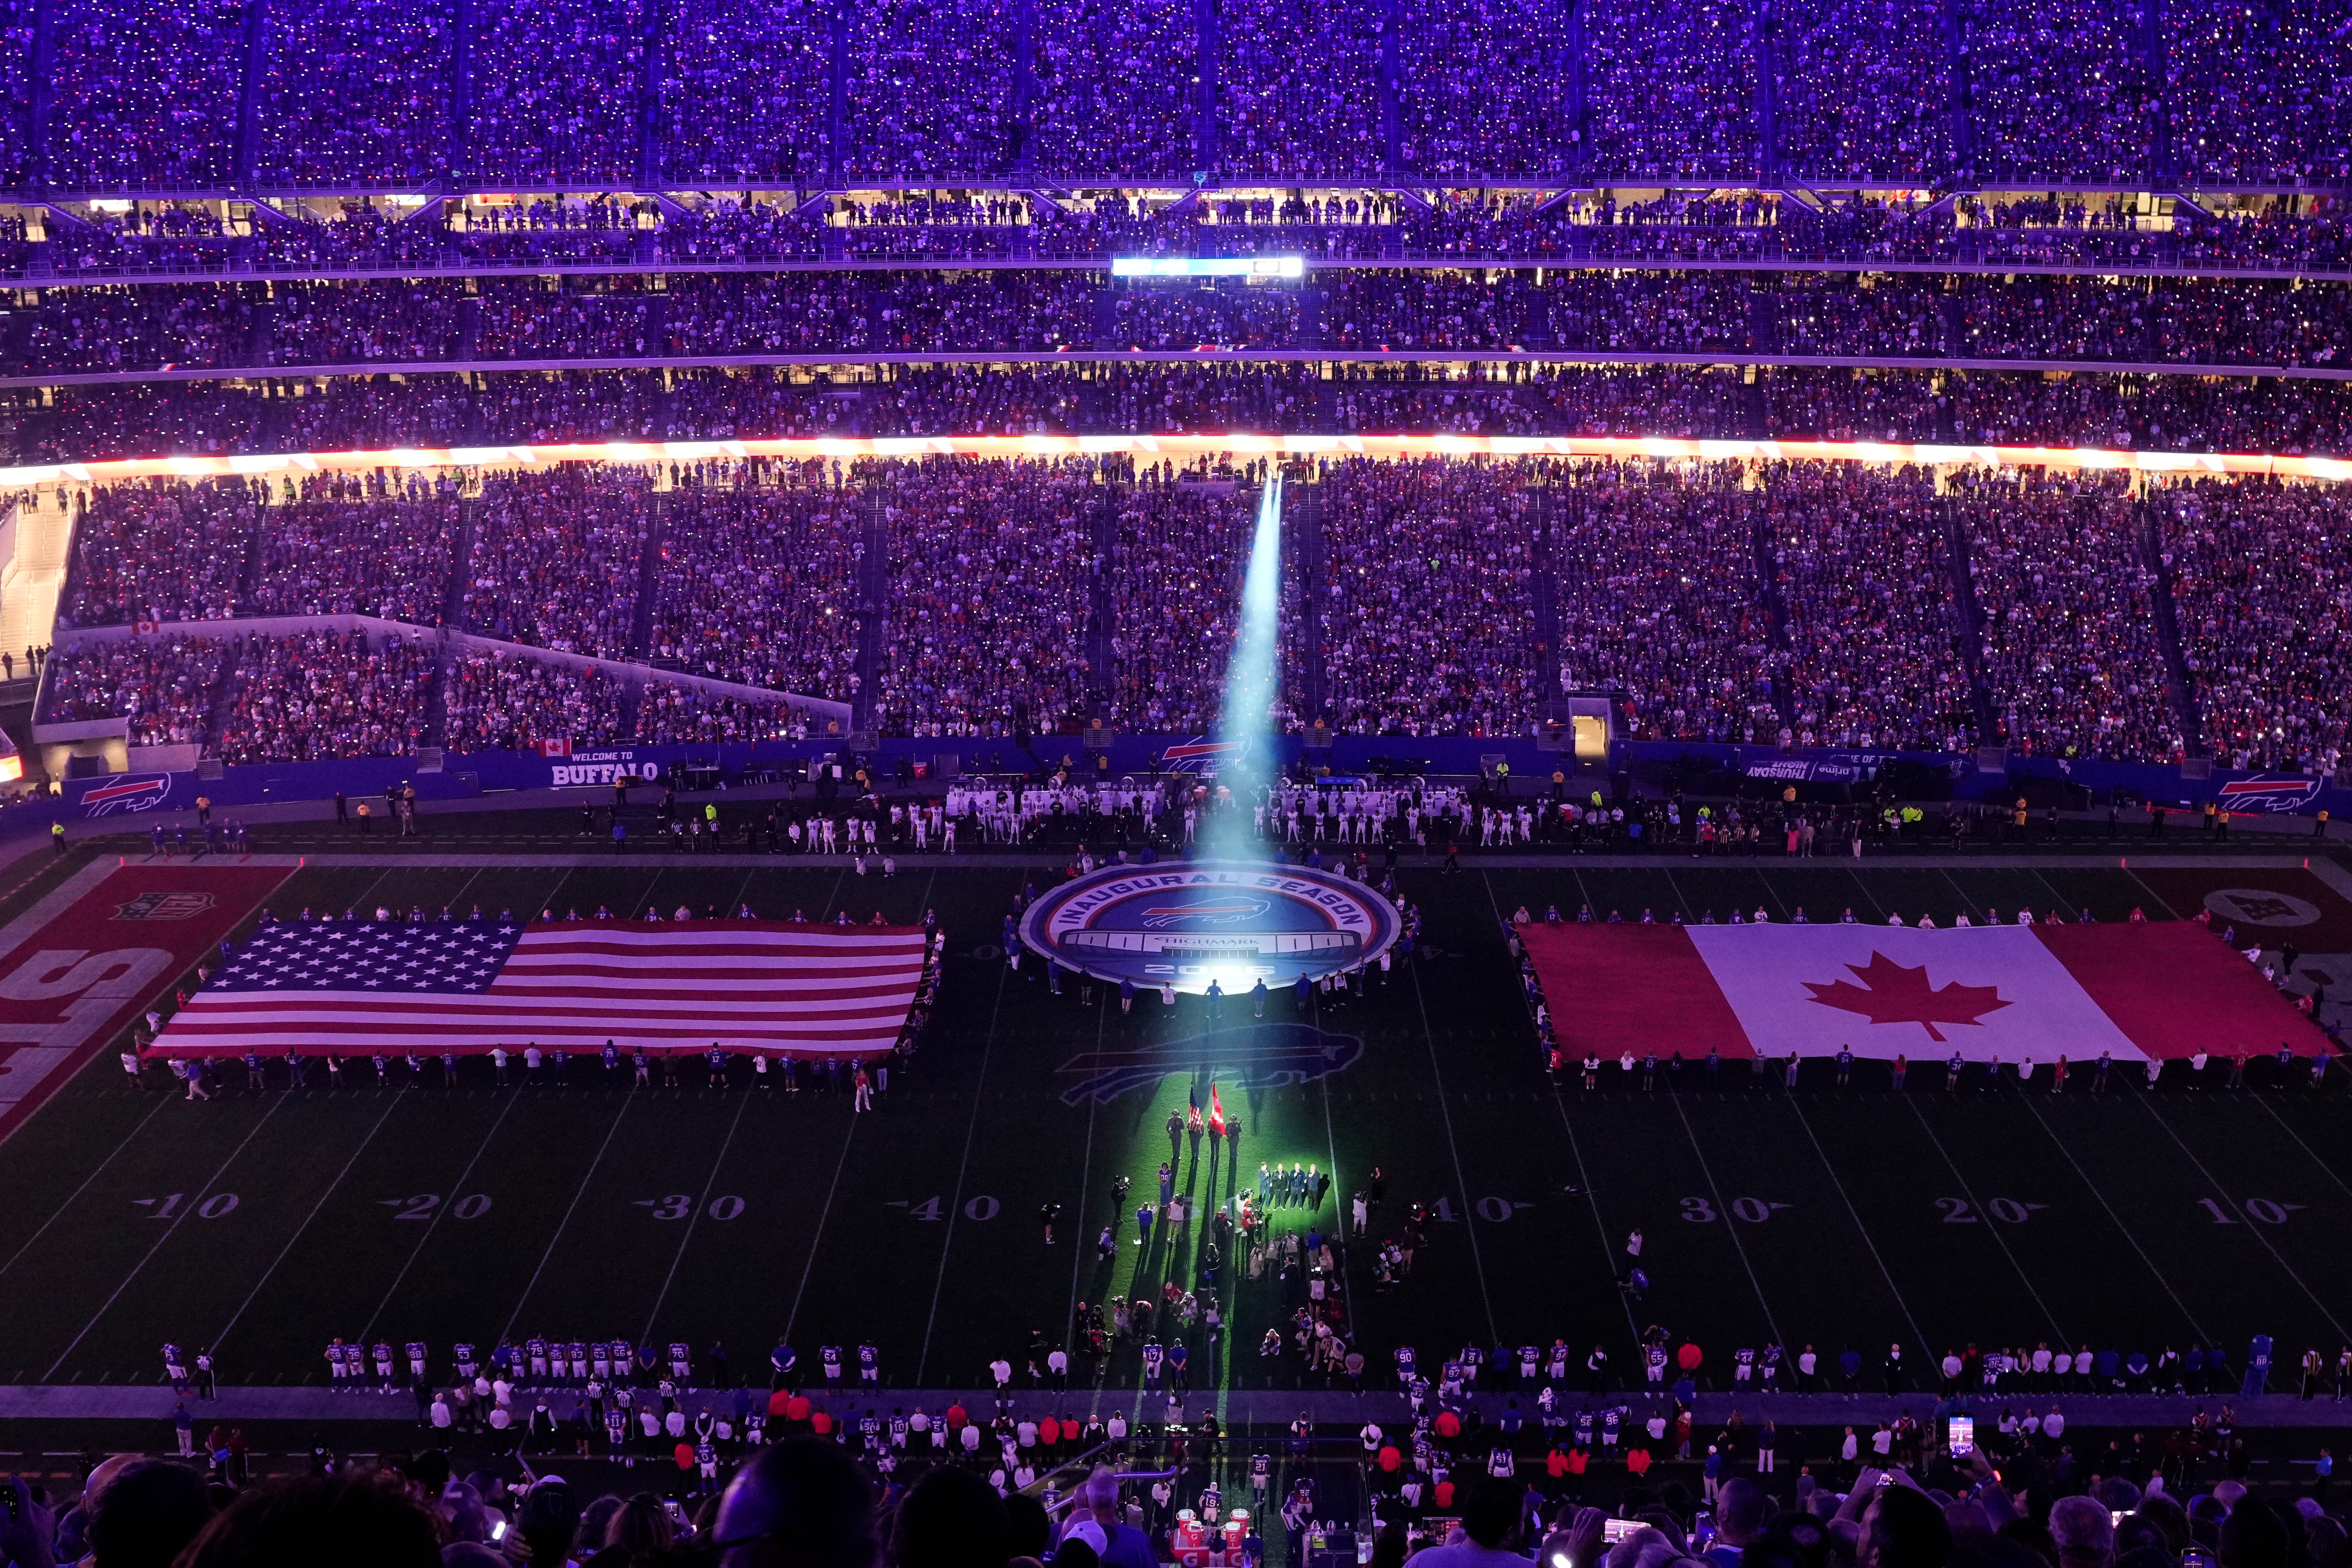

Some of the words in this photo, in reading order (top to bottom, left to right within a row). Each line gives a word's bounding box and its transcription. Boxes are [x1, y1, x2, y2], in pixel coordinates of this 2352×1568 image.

[572, 752, 618, 761] WELCOME
[552, 763, 658, 785] BUFFALO
[1747, 767, 1806, 779] THURSDAY
[1819, 766, 1849, 775] prime
[1058, 873, 1239, 924] INAUGURAL
[1255, 875, 1365, 925] SEASON
[1144, 964, 1275, 975] 206
[147, 1194, 239, 1218] 10
[395, 1194, 492, 1219] 20
[653, 1195, 745, 1220] 30
[909, 1196, 1000, 1220] 40
[1680, 1197, 1769, 1222] 30
[1934, 1197, 2028, 1223] 20
[2198, 1198, 2287, 1224] 10
[531, 1347, 543, 1355] 79
[1148, 1352, 1158, 1360] 17
[1400, 1353, 1412, 1363] 90
[1448, 1369, 1460, 1377] 97
[1545, 1403, 1551, 1412] 8
[611, 1418, 620, 1427] 11
[1417, 1419, 1429, 1428] 42
[1581, 1418, 1592, 1426] 56
[1606, 1415, 1618, 1425] 96
[864, 1425, 875, 1433] 20
[1415, 1447, 1427, 1457] 23
[1496, 1455, 1506, 1464] 51
[1255, 1463, 1265, 1472] 21
[1205, 1497, 1216, 1507] 19
[1183, 1552, 1198, 1567] G
